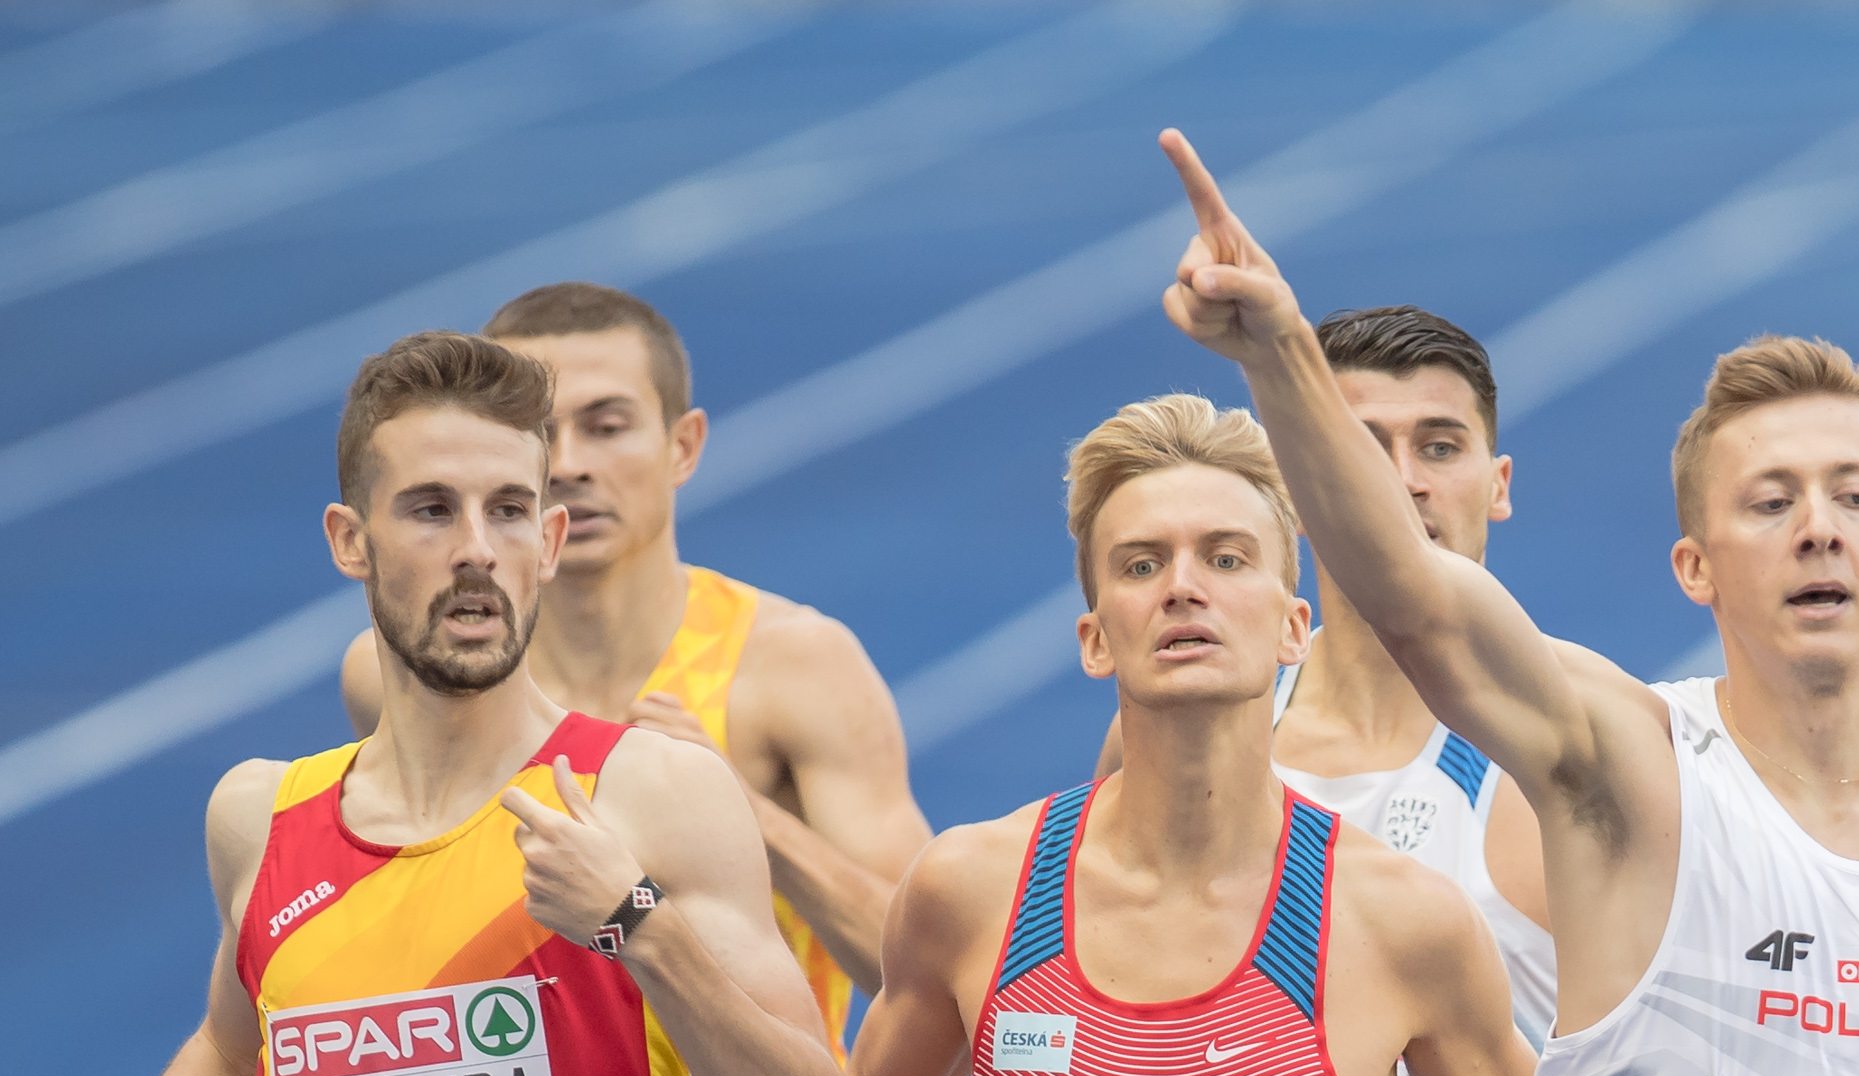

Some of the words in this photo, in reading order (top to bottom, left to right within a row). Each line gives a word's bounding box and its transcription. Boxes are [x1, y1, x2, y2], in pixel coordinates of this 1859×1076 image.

[1744, 929, 1815, 972] 4F
[275, 1006, 455, 1076] SPAR
[1002, 1029, 1047, 1047] ČESKÁ
